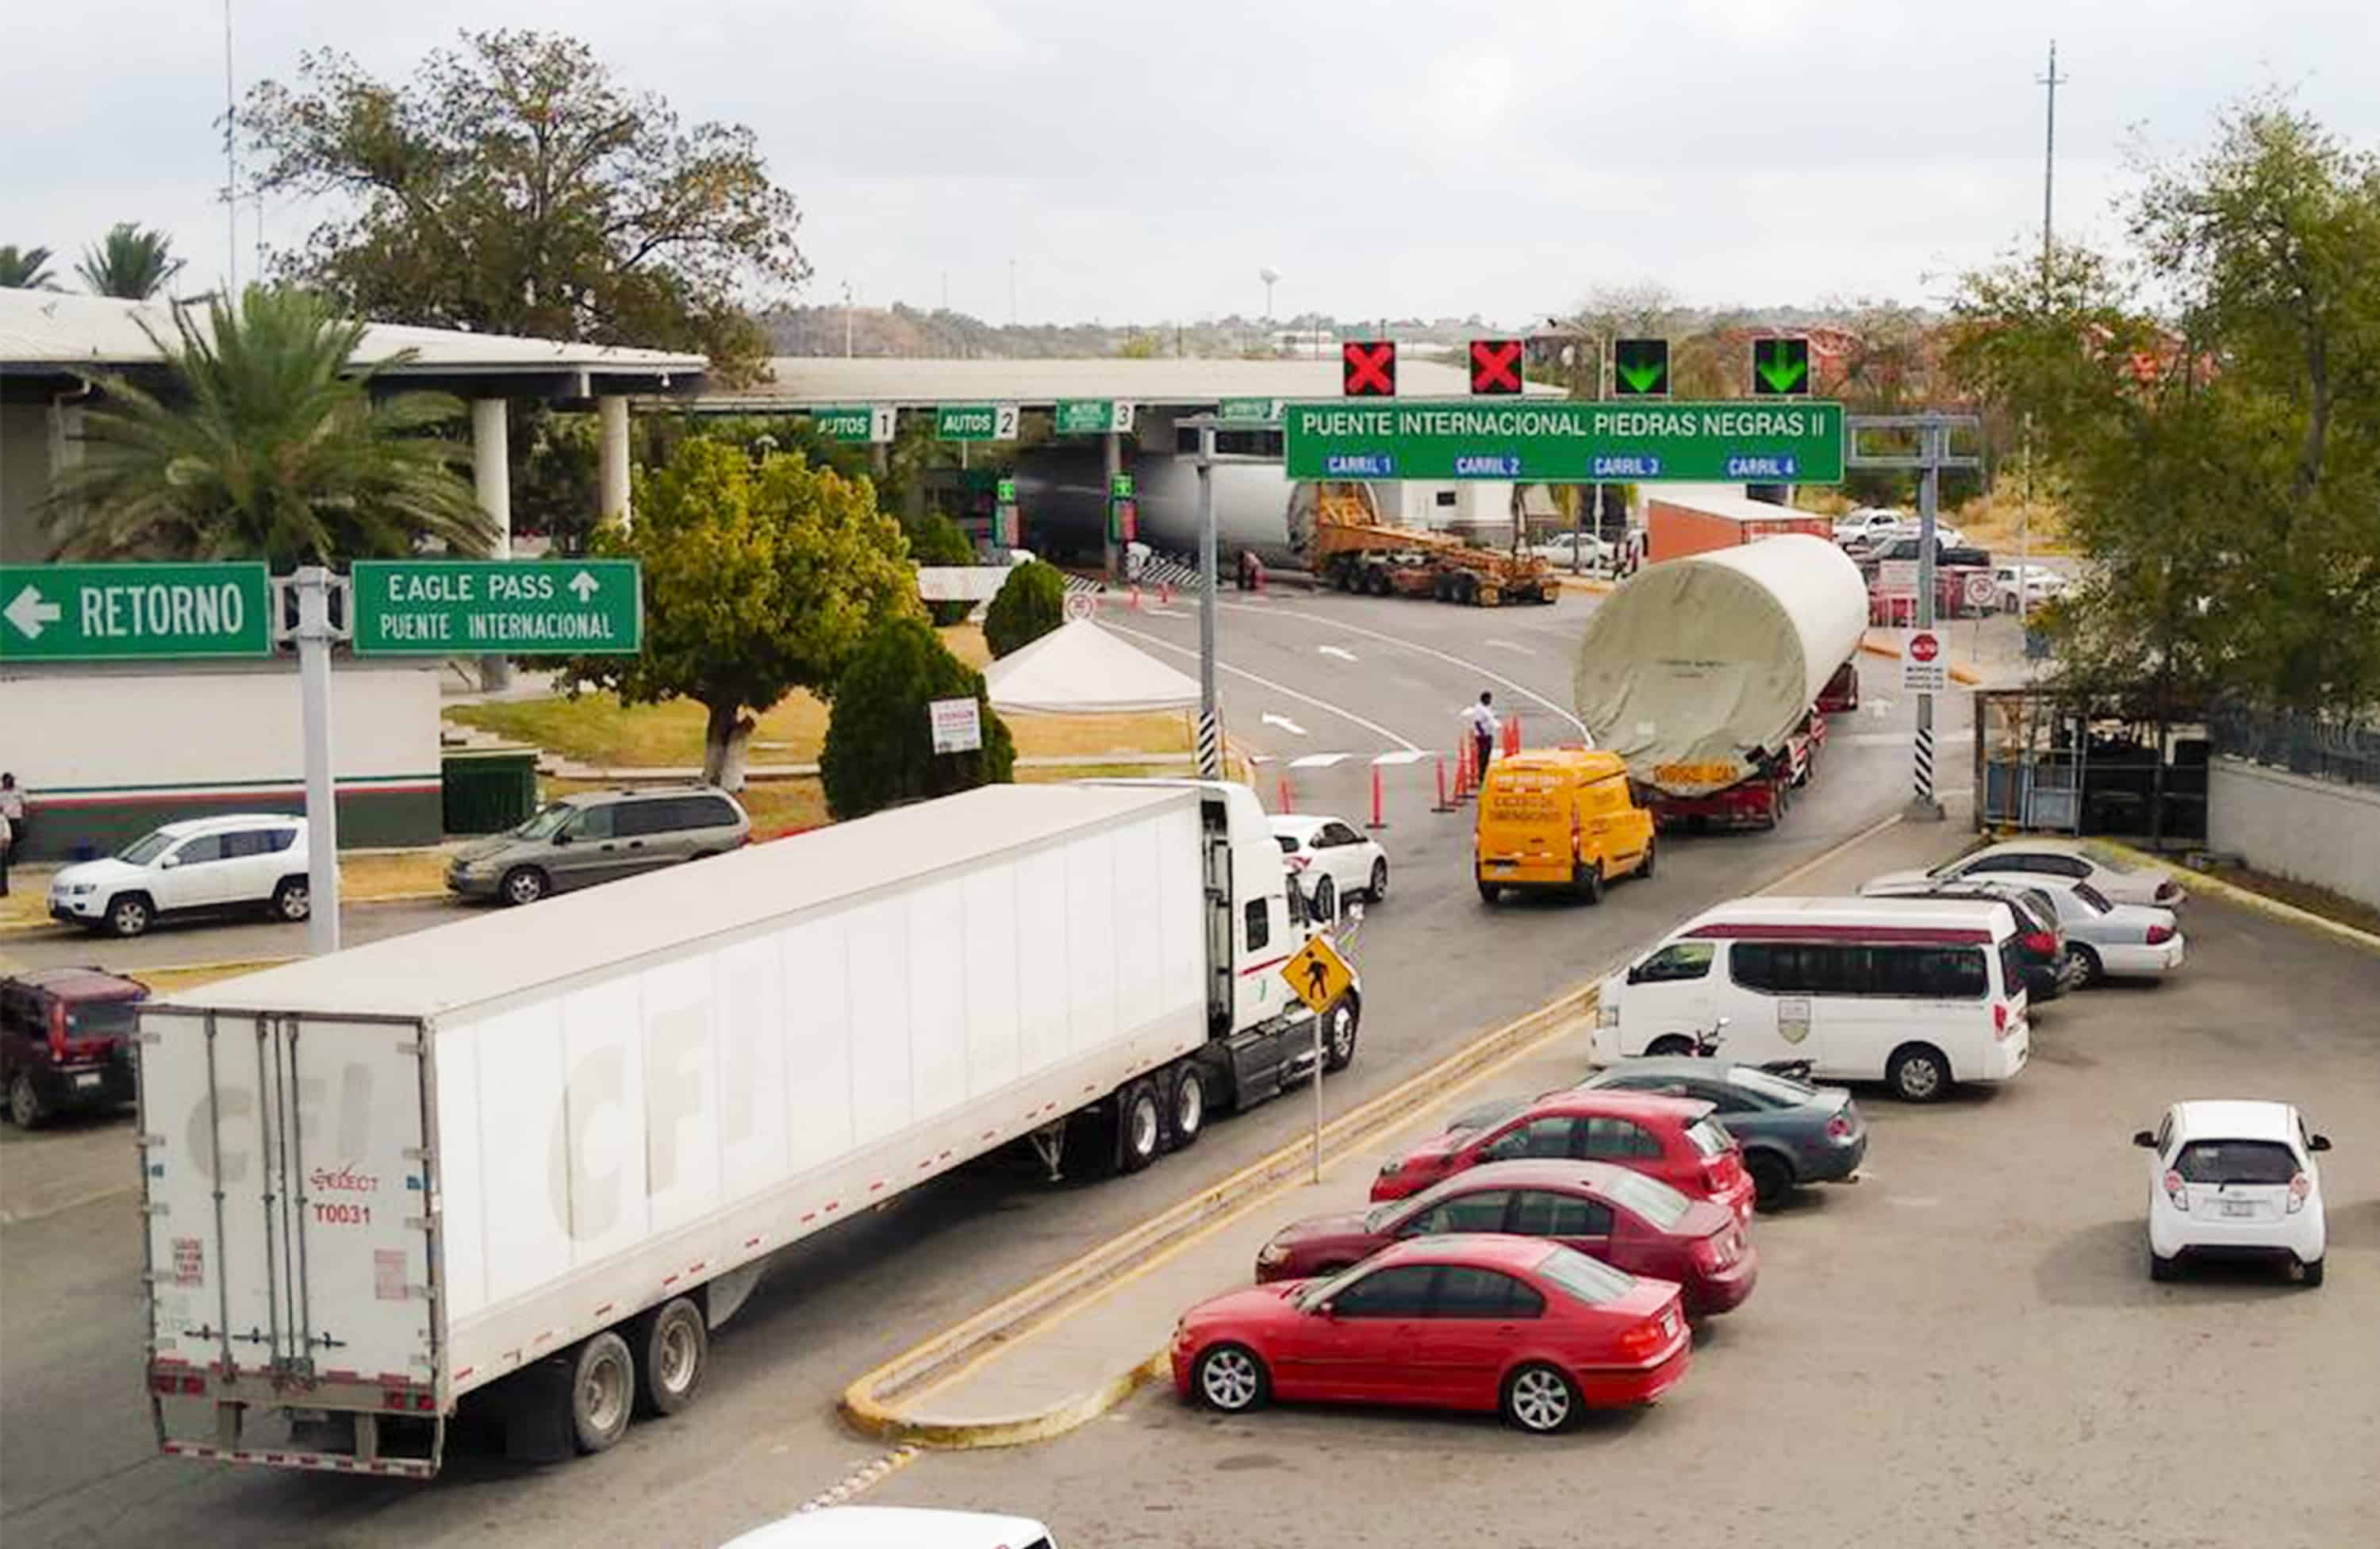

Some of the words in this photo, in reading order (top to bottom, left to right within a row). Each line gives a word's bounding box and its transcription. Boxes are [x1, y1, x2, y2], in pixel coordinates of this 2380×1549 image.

[880, 413, 889, 436] 1
[942, 413, 992, 432] AUTOS
[1001, 412, 1013, 433] 2
[1117, 405, 1130, 426] 3
[1302, 412, 1392, 436] PUENTE
[1398, 412, 1587, 436] INTERNACIONAL
[1594, 413, 1697, 436] PIEDRAS
[1702, 413, 1805, 436] NEGRAS
[1811, 413, 1825, 436] II
[1327, 455, 1379, 475] CARRIL
[1384, 455, 1392, 474] 1
[1456, 456, 1507, 475] CARRIL
[1511, 457, 1521, 475] 2
[1594, 457, 1645, 475] CARRIL
[1728, 457, 1780, 476] CARRIL
[1784, 458, 1795, 475] 4
[388, 574, 475, 602] EAGLE
[488, 574, 555, 601] PASS
[80, 582, 244, 637] RETORNO
[380, 613, 452, 640] PUENTE
[469, 612, 616, 640] INTERNACIONAL
[314, 1202, 371, 1226] T0031
